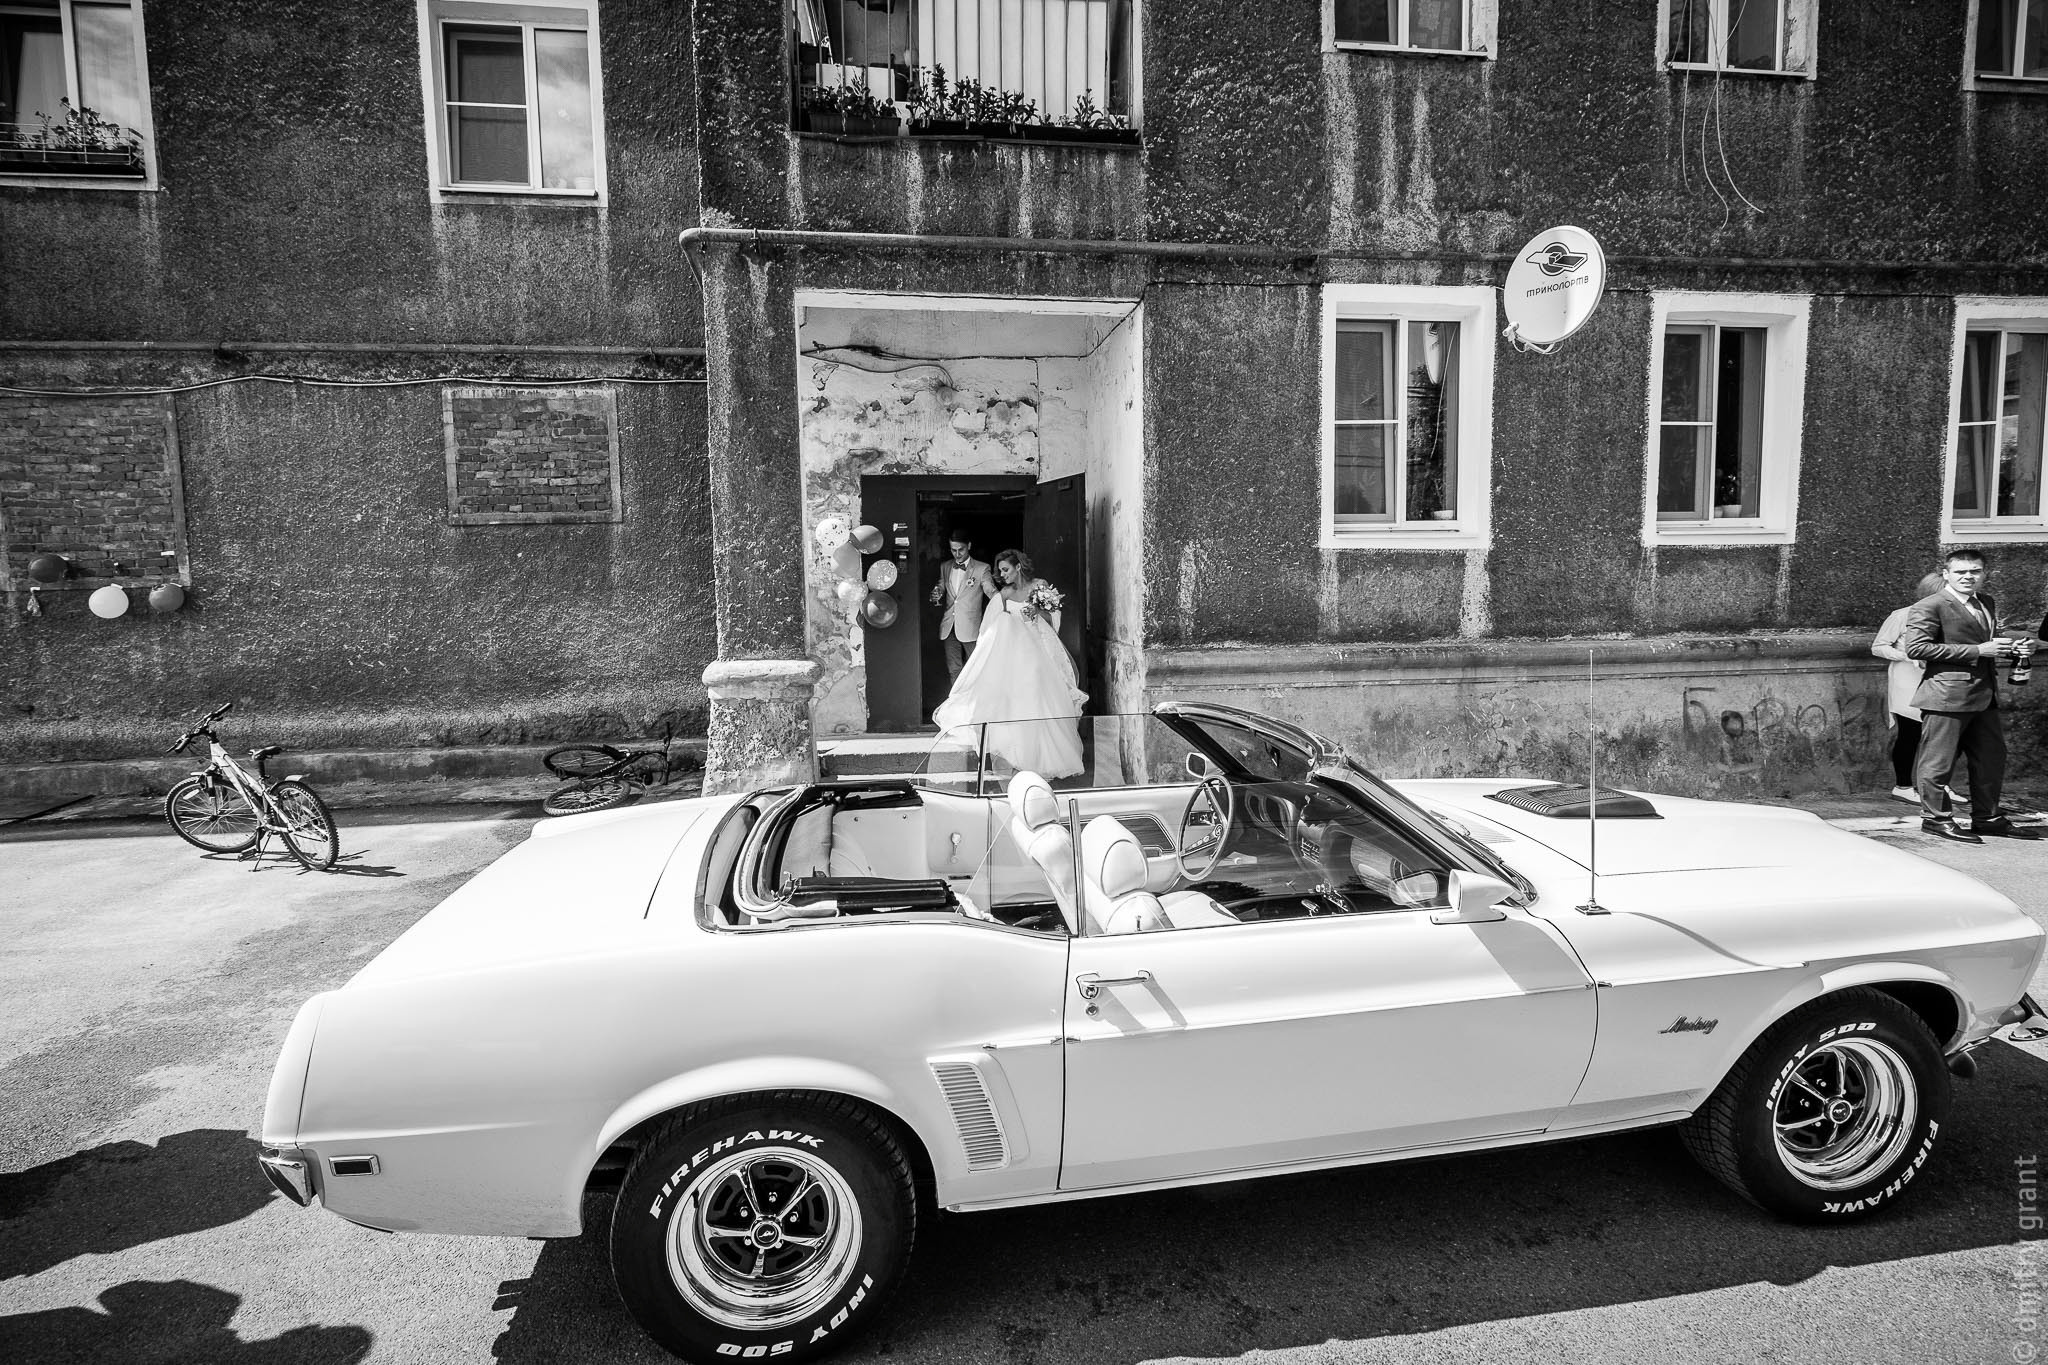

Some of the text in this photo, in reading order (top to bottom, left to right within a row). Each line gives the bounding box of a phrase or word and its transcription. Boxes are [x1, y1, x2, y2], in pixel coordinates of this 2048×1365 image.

[1766, 1022, 1877, 1110] INDY 500
[649, 1129, 825, 1219] FIREHAWK
[1821, 1119, 1939, 1214] FIREHAWK
[716, 1273, 874, 1358] INDY 500
